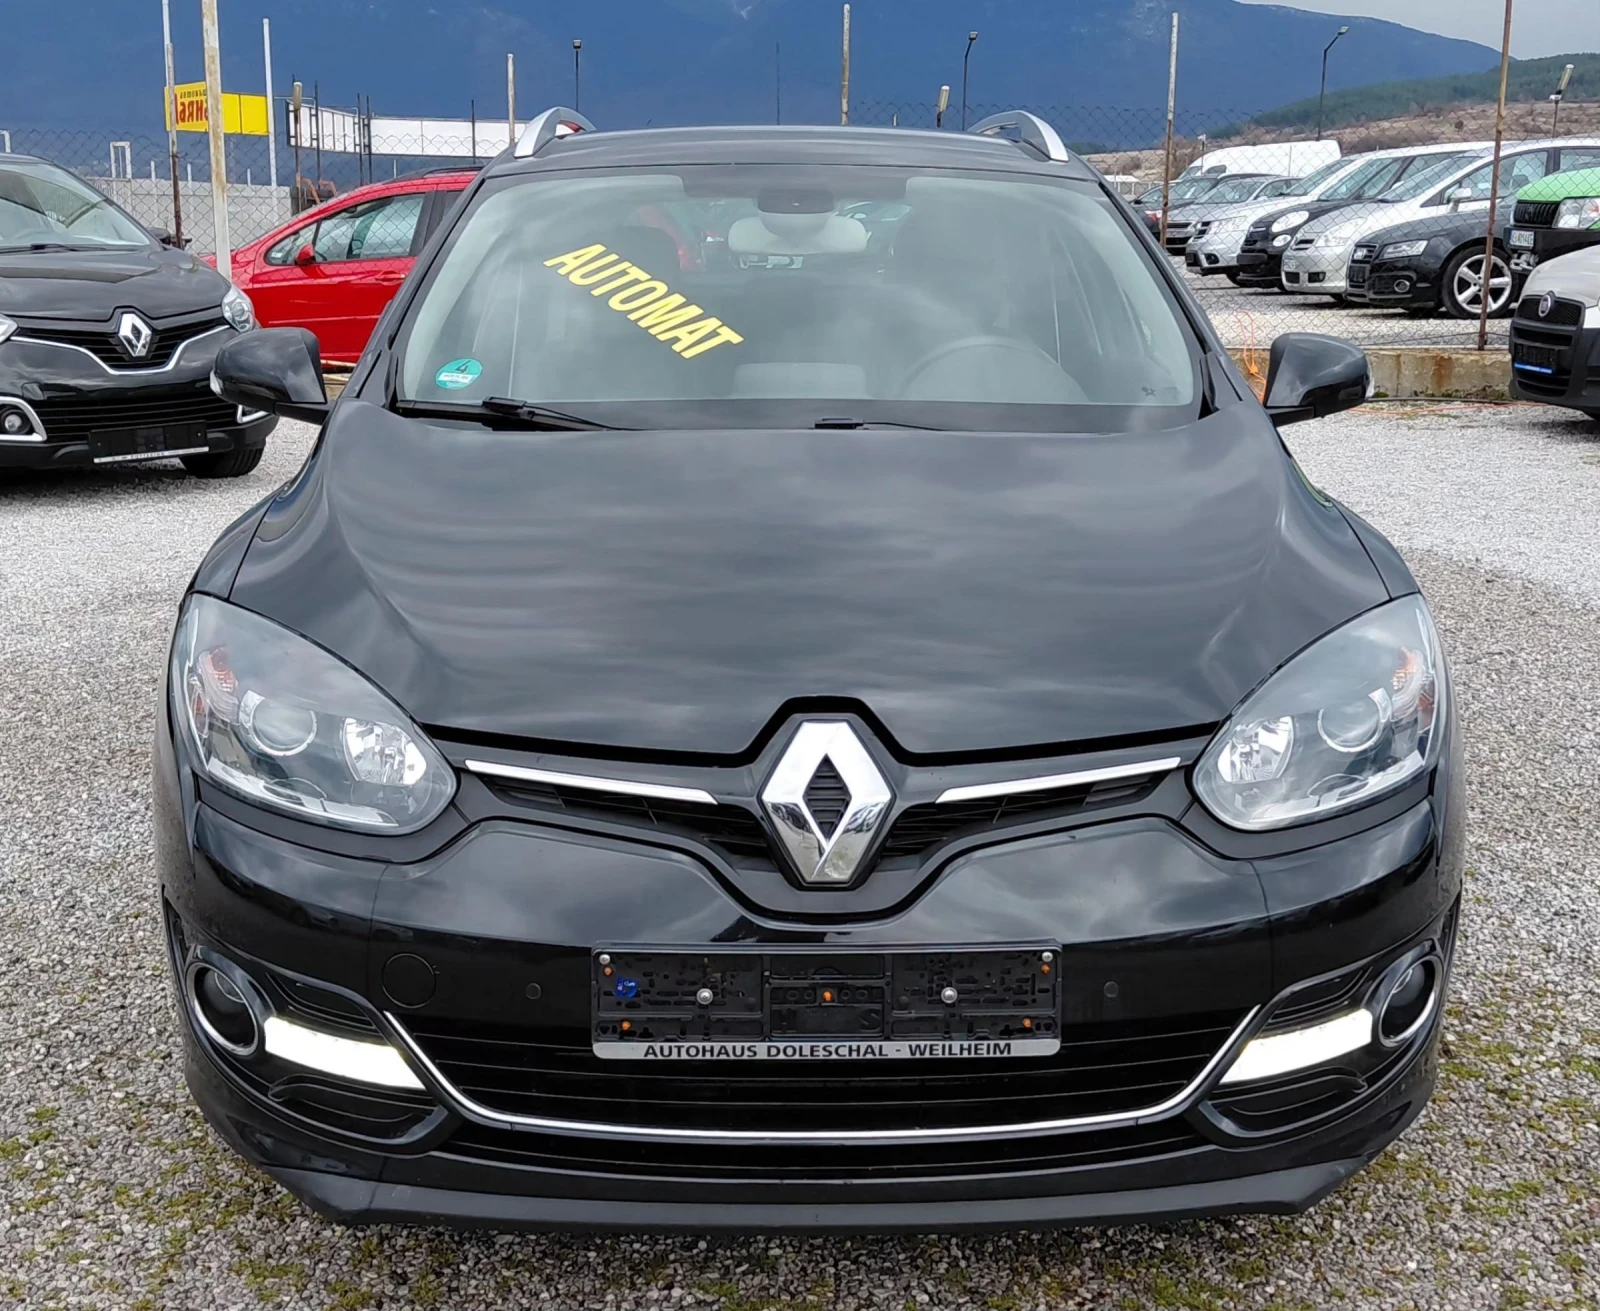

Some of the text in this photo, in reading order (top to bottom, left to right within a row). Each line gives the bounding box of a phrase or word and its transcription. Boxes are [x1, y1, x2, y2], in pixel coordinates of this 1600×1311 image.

[543, 243, 744, 359] AUTOMAT
[455, 360, 471, 373] 4
[643, 1044, 758, 1058] AUTOHAUS
[766, 1044, 888, 1058] DOLESCHAL
[908, 1042, 1012, 1057] WEILHEIM
